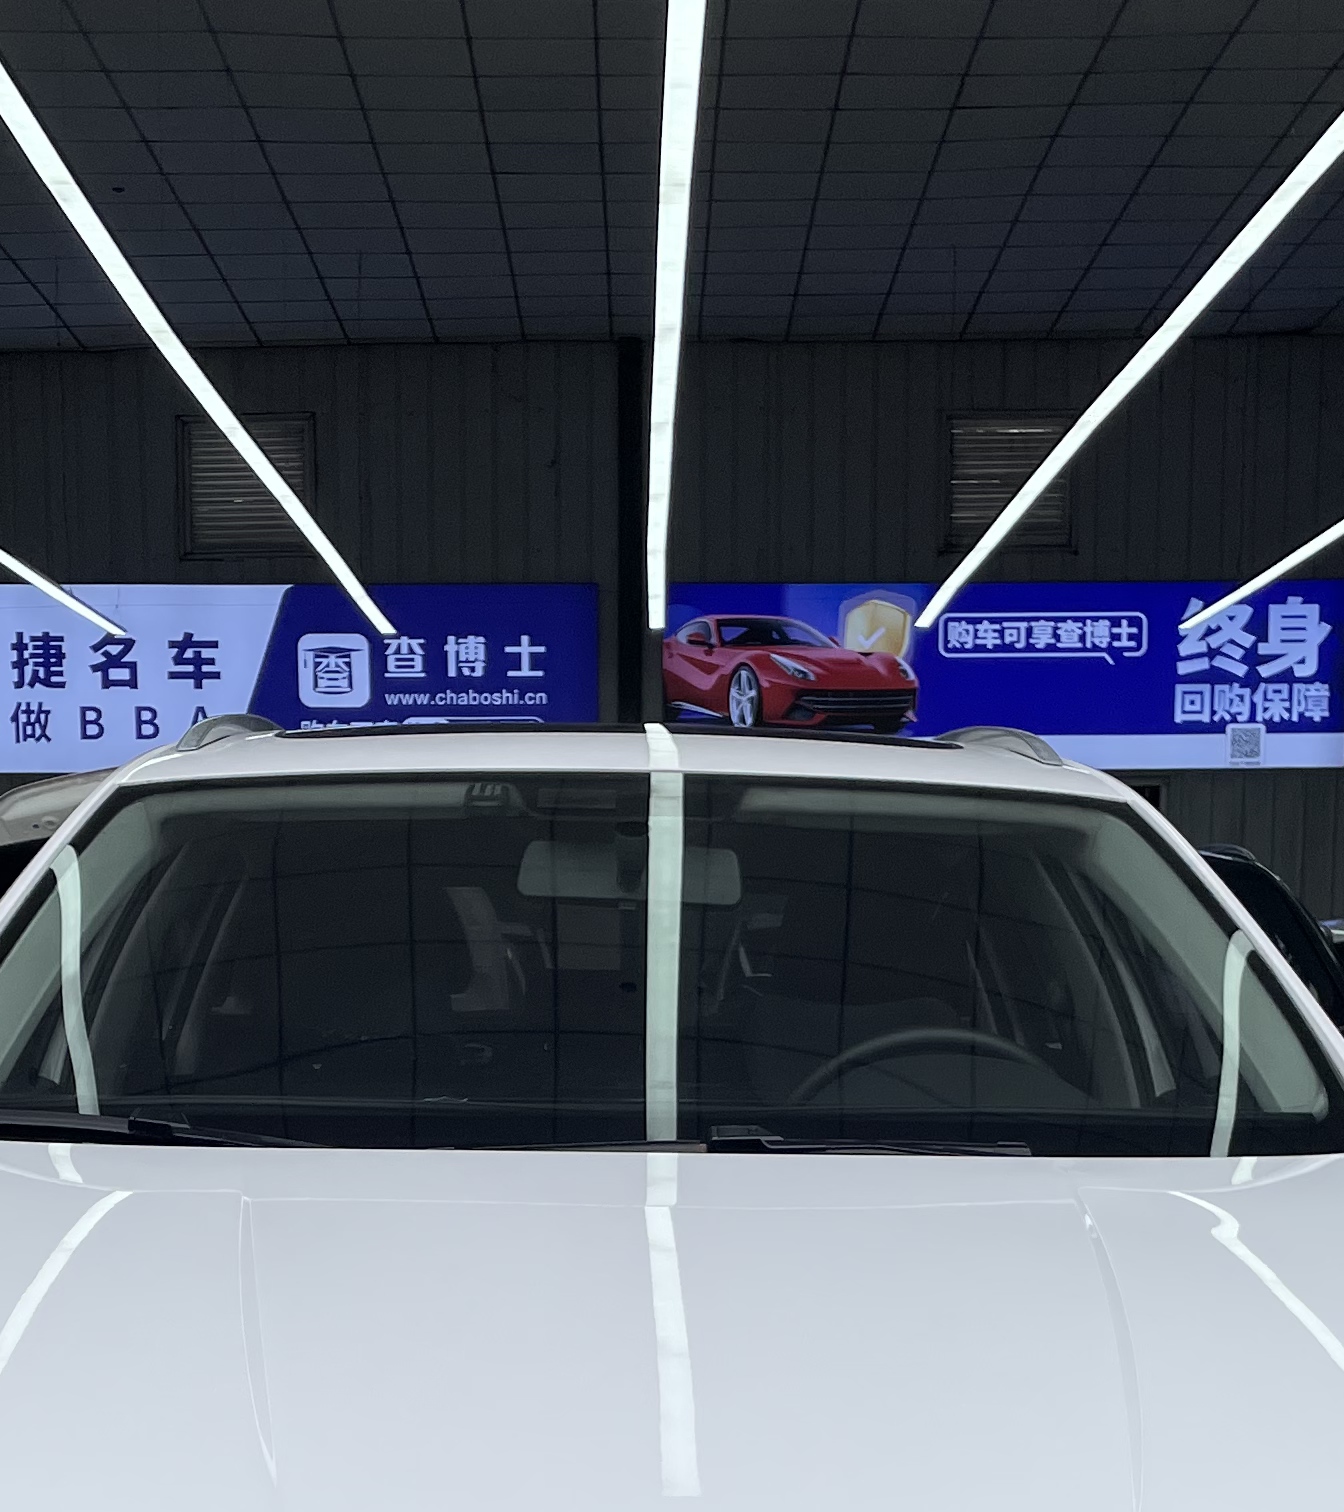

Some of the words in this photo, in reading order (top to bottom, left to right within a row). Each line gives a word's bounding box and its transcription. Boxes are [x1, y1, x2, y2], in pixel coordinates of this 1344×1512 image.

[947, 619, 1139, 650] 购车可享查博士
[1176, 596, 1332, 678] 终身
[383, 634, 548, 679] 查博士
[384, 688, 549, 706] www.chaboshi.cn
[1174, 682, 1331, 723] 回购保障
